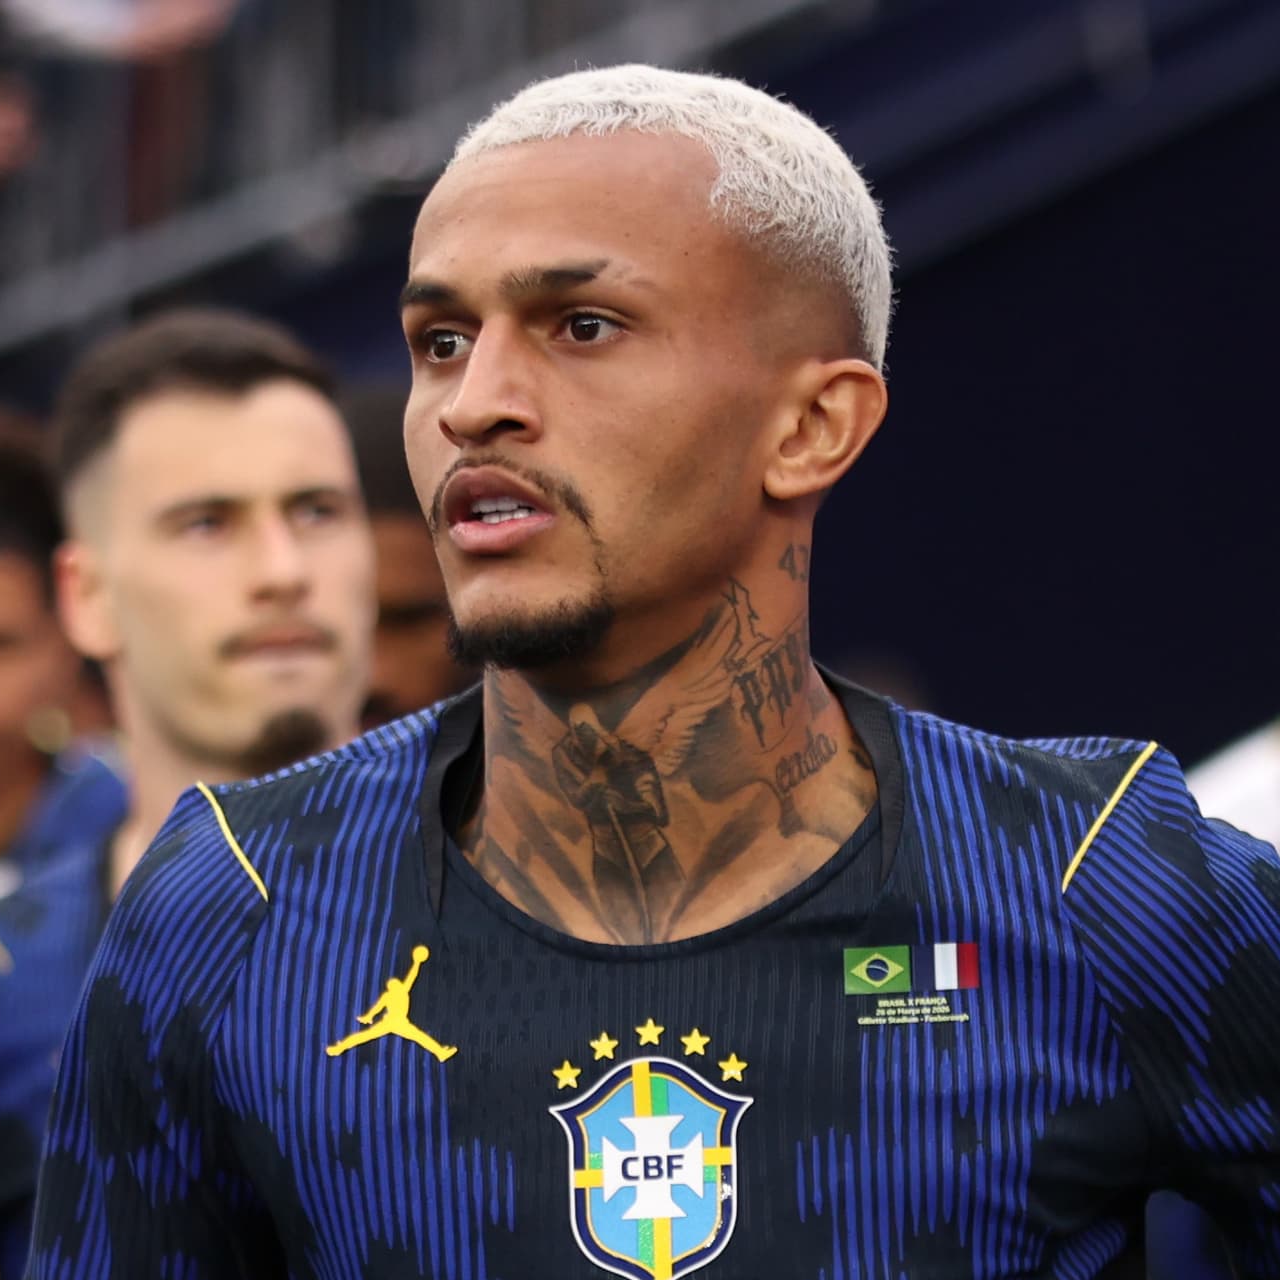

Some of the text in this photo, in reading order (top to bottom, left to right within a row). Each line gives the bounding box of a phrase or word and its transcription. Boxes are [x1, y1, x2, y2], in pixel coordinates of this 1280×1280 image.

[878, 999, 906, 1008] BRASIL
[915, 997, 947, 1007] FRANÇA
[888, 1015, 920, 1024] Stadium
[621, 1154, 685, 1181] CBF
